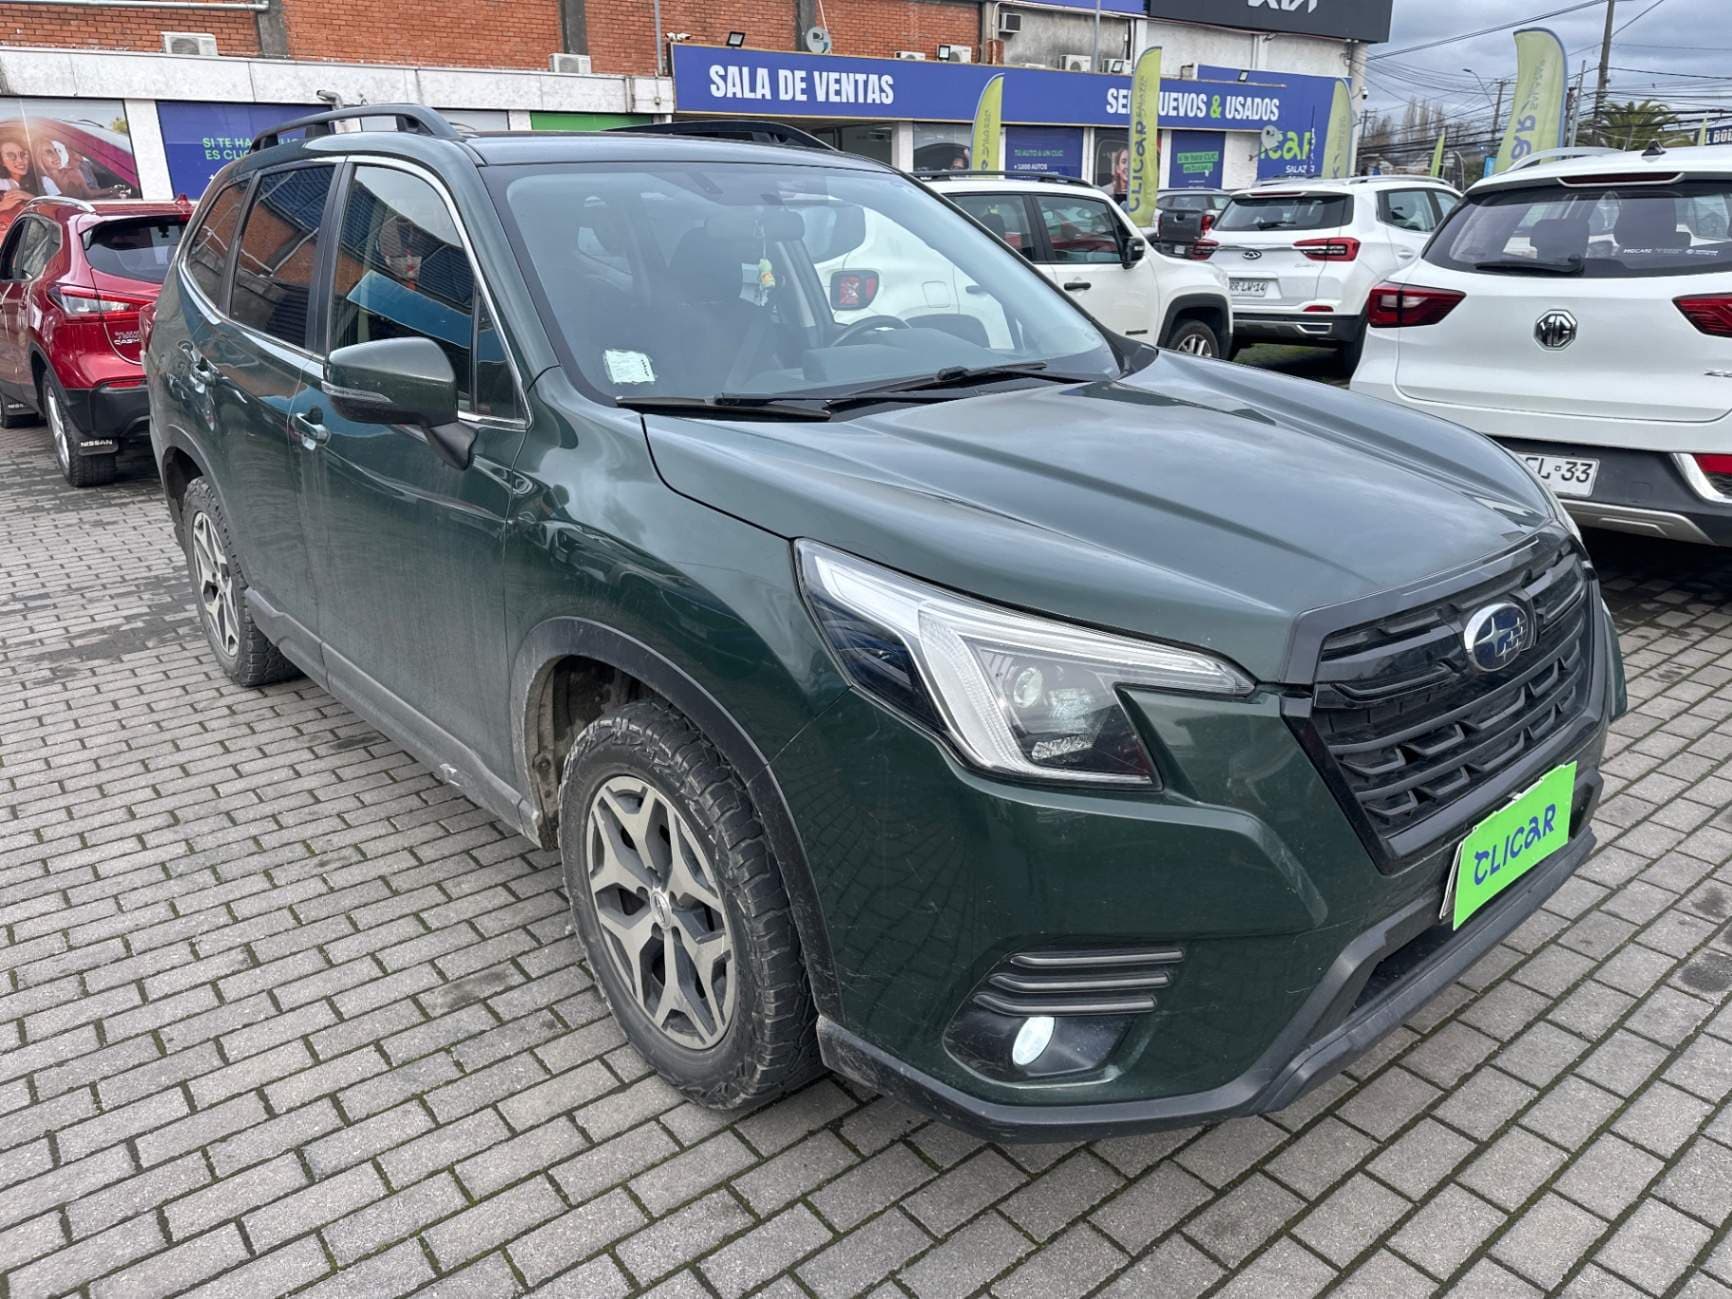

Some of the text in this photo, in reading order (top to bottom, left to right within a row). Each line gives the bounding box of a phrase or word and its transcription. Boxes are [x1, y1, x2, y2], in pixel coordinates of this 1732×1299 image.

[709, 64, 894, 105] SALA DE VENTAS
[1210, 95, 1222, 119] &
[1225, 95, 1280, 121] USADOS
[217, 137, 231, 149] TE
[204, 150, 221, 161] ES
